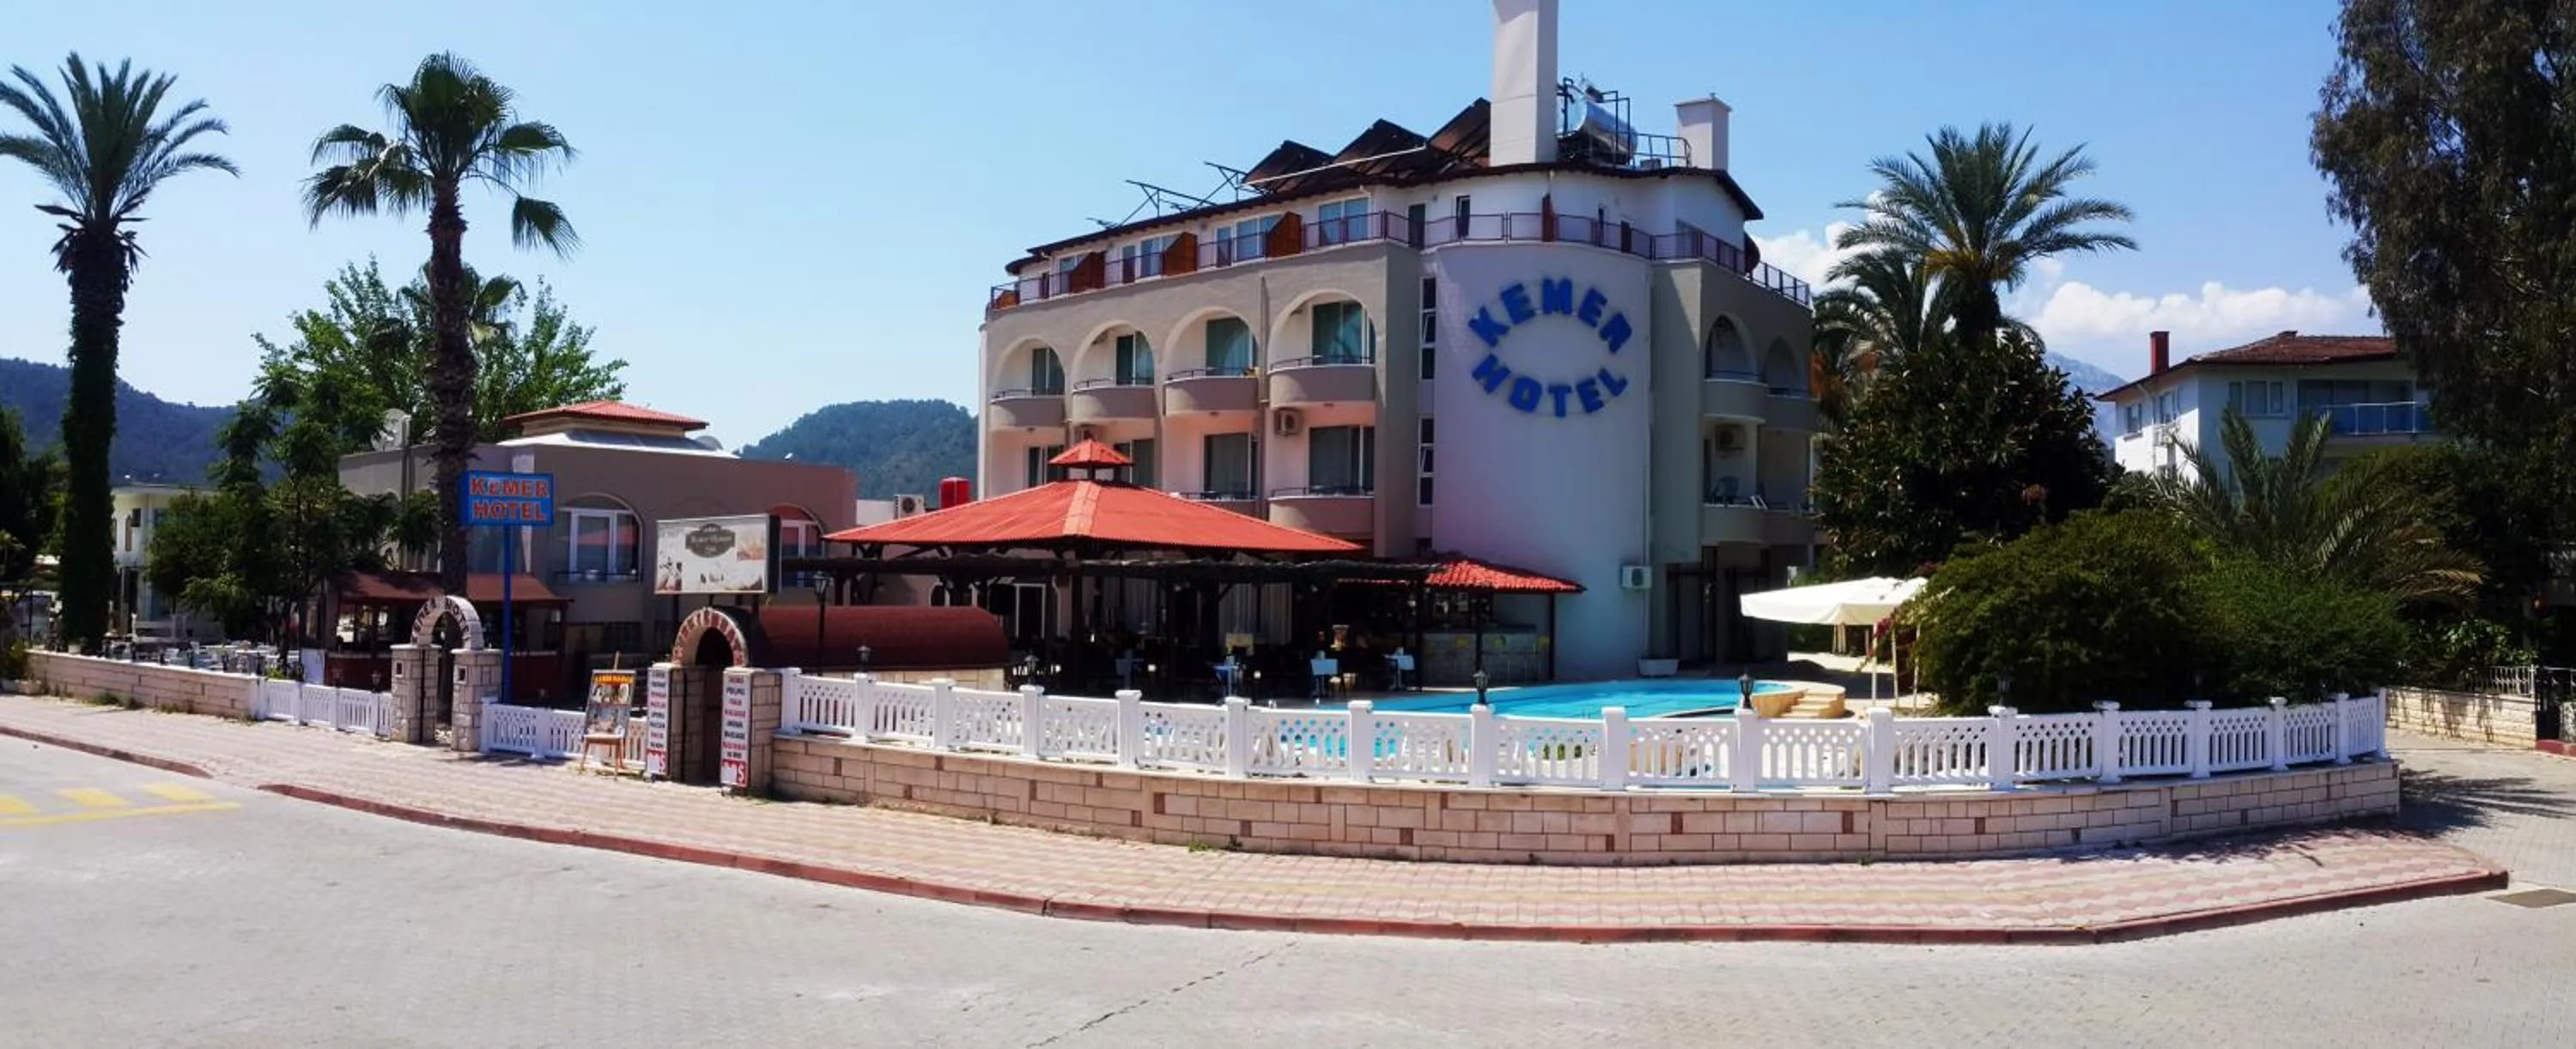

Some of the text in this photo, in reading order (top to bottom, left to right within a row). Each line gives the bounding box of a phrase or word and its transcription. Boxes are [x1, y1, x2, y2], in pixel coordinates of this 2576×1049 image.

[1467, 276, 1632, 354] KEMER
[1471, 353, 1628, 418] HOTEL
[472, 500, 547, 521] HOTEL
